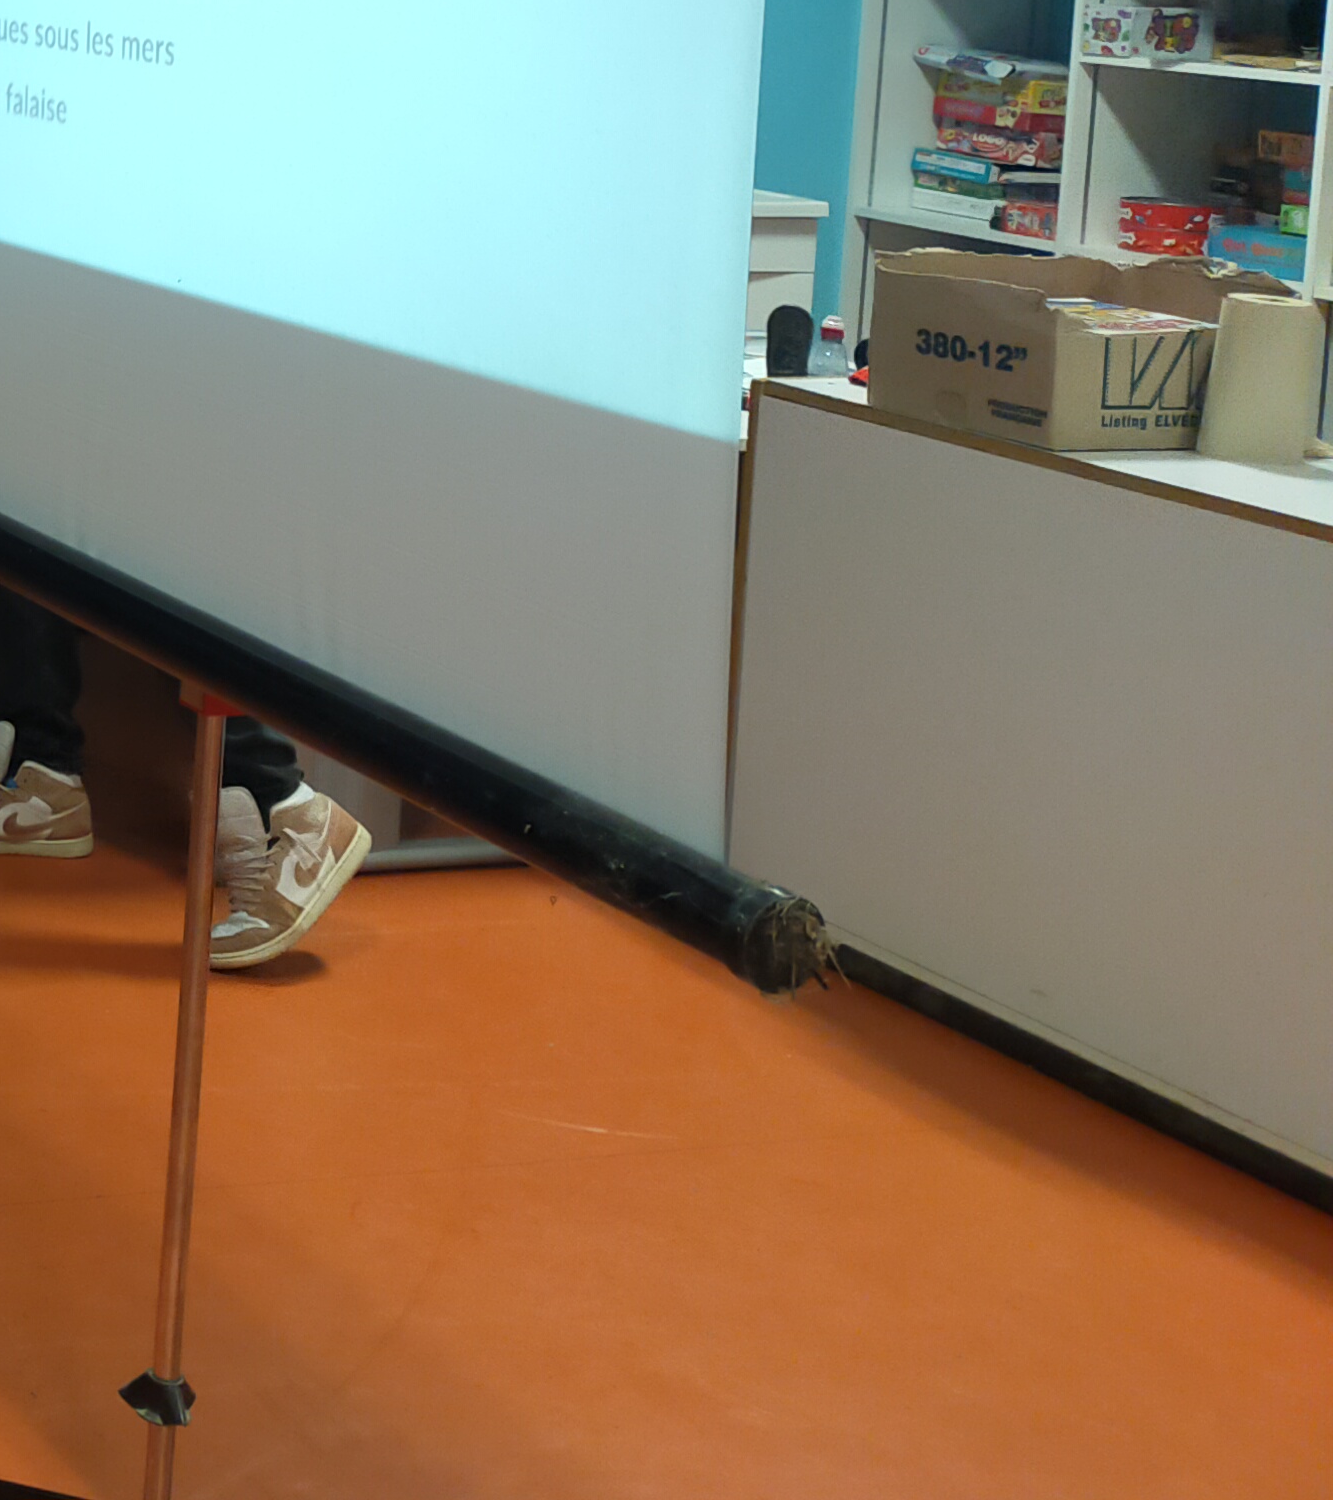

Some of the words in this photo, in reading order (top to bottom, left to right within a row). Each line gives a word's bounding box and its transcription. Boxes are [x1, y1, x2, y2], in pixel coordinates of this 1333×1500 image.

[35, 22, 79, 52] sous
[87, 21, 113, 57] les
[122, 35, 174, 66] mers
[6, 81, 67, 124] falaise
[1101, 415, 1147, 430] Listing
